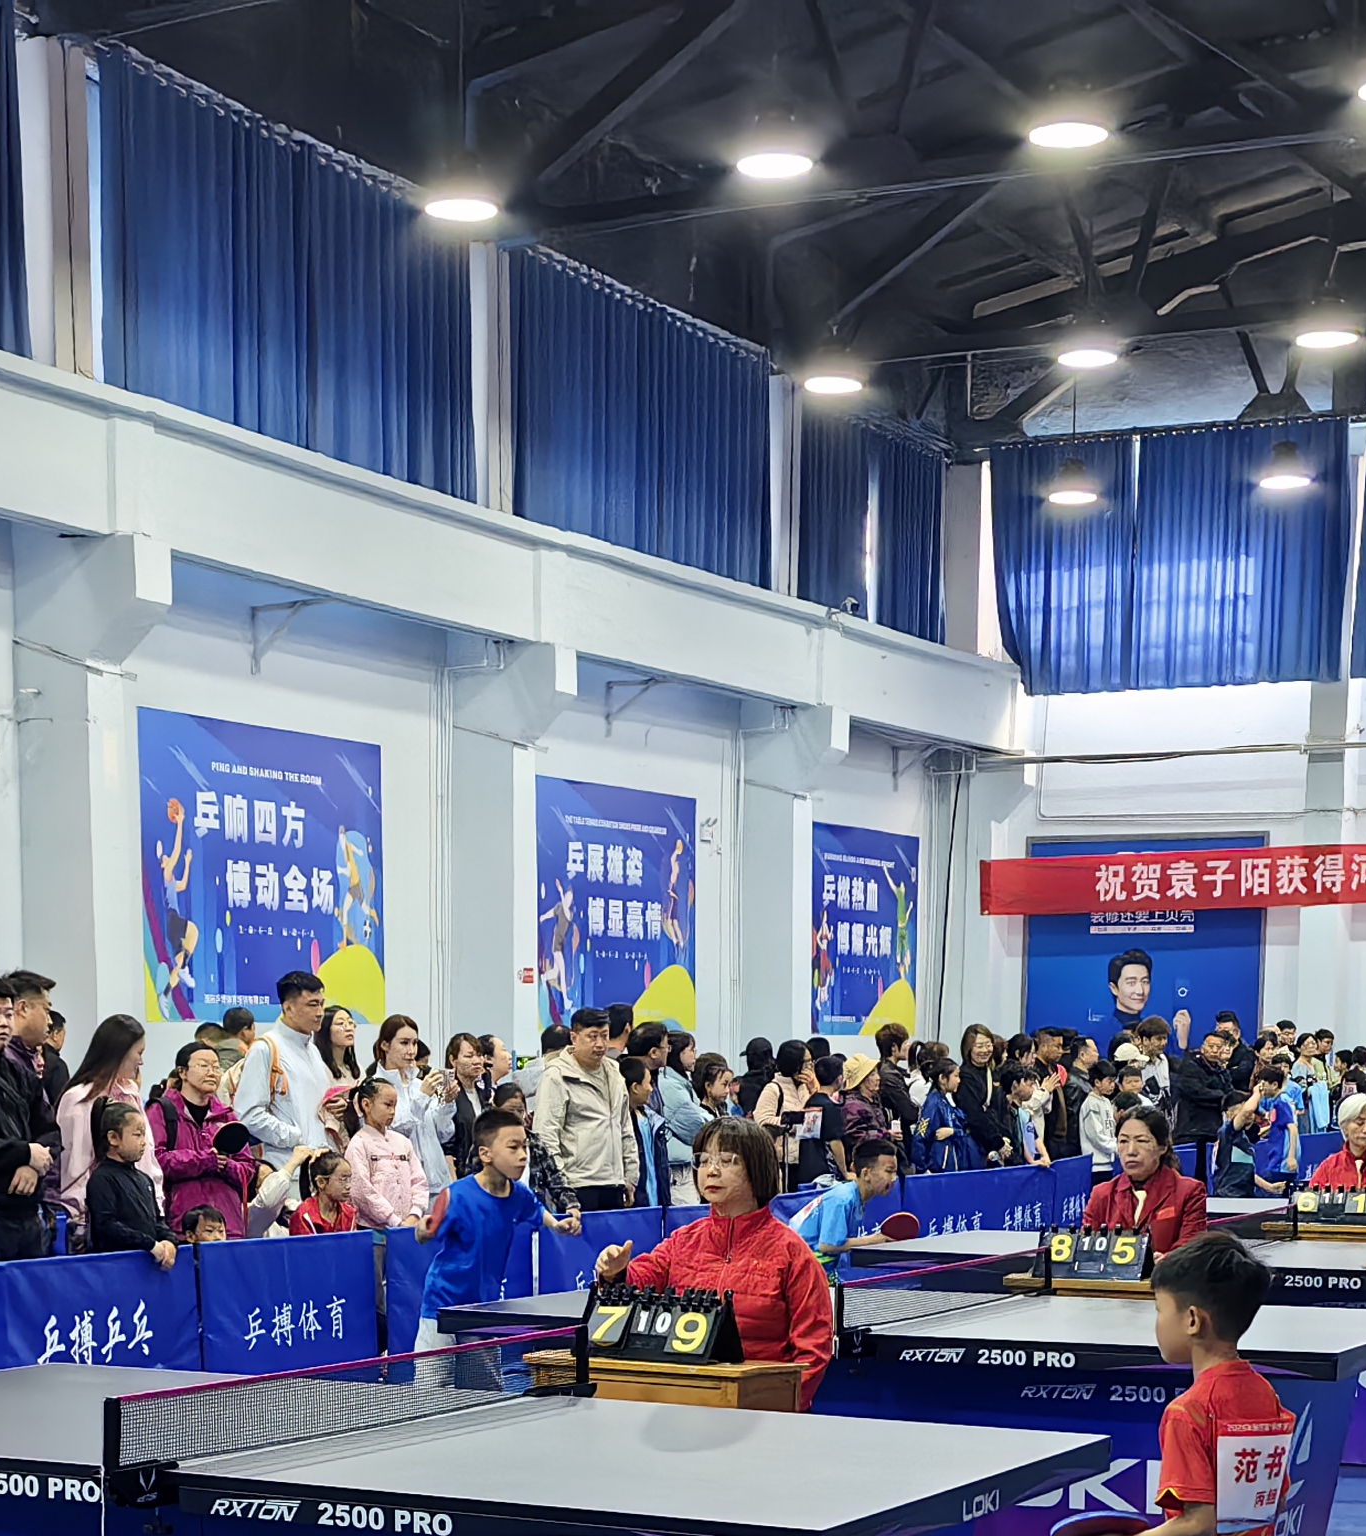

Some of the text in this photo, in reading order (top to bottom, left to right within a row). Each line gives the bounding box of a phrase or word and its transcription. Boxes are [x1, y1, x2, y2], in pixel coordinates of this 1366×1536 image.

[193, 790, 306, 849] 乒响四方
[566, 841, 643, 887] 乒展雄姿
[225, 859, 335, 915] 博动全场
[1296, 1191, 1317, 1212] 6
[1352, 1192, 1366, 1214] 1
[1050, 1234, 1074, 1262] 8
[1111, 1236, 1137, 1265] 5
[1283, 1274, 1362, 1290] 2500 PRO
[243, 1295, 346, 1351] 乒搏体育
[591, 1305, 629, 1341] 7
[671, 1311, 709, 1353] 9
[899, 1348, 1076, 1368] RXTON 2500 PRO
[1109, 1384, 1166, 1403] 2500
[47, 1476, 102, 1503] PRO
[962, 1488, 1000, 1522] LOKI
[209, 1499, 303, 1523] RXTON
[317, 1503, 386, 1531] 2500
